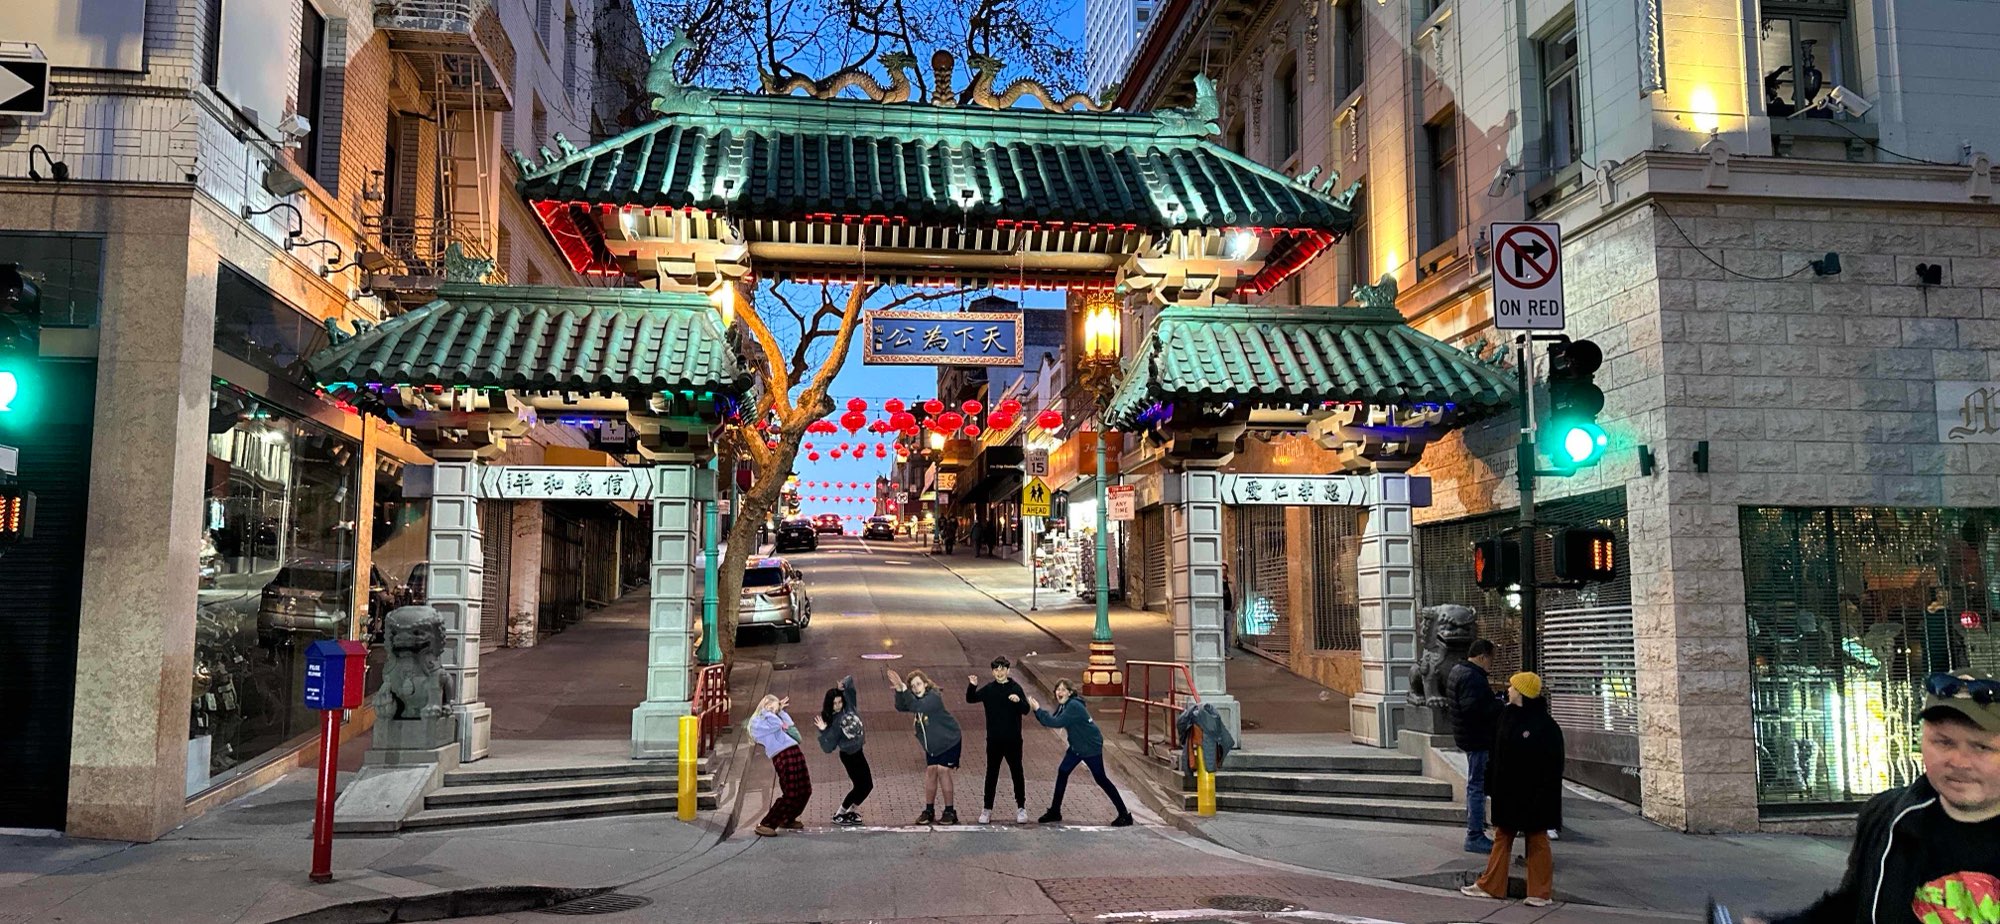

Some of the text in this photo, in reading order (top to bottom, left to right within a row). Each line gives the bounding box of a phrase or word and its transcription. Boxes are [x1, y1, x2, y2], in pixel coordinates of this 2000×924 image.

[1499, 299, 1559, 316] ON RED
[1031, 462, 1045, 473] 15
